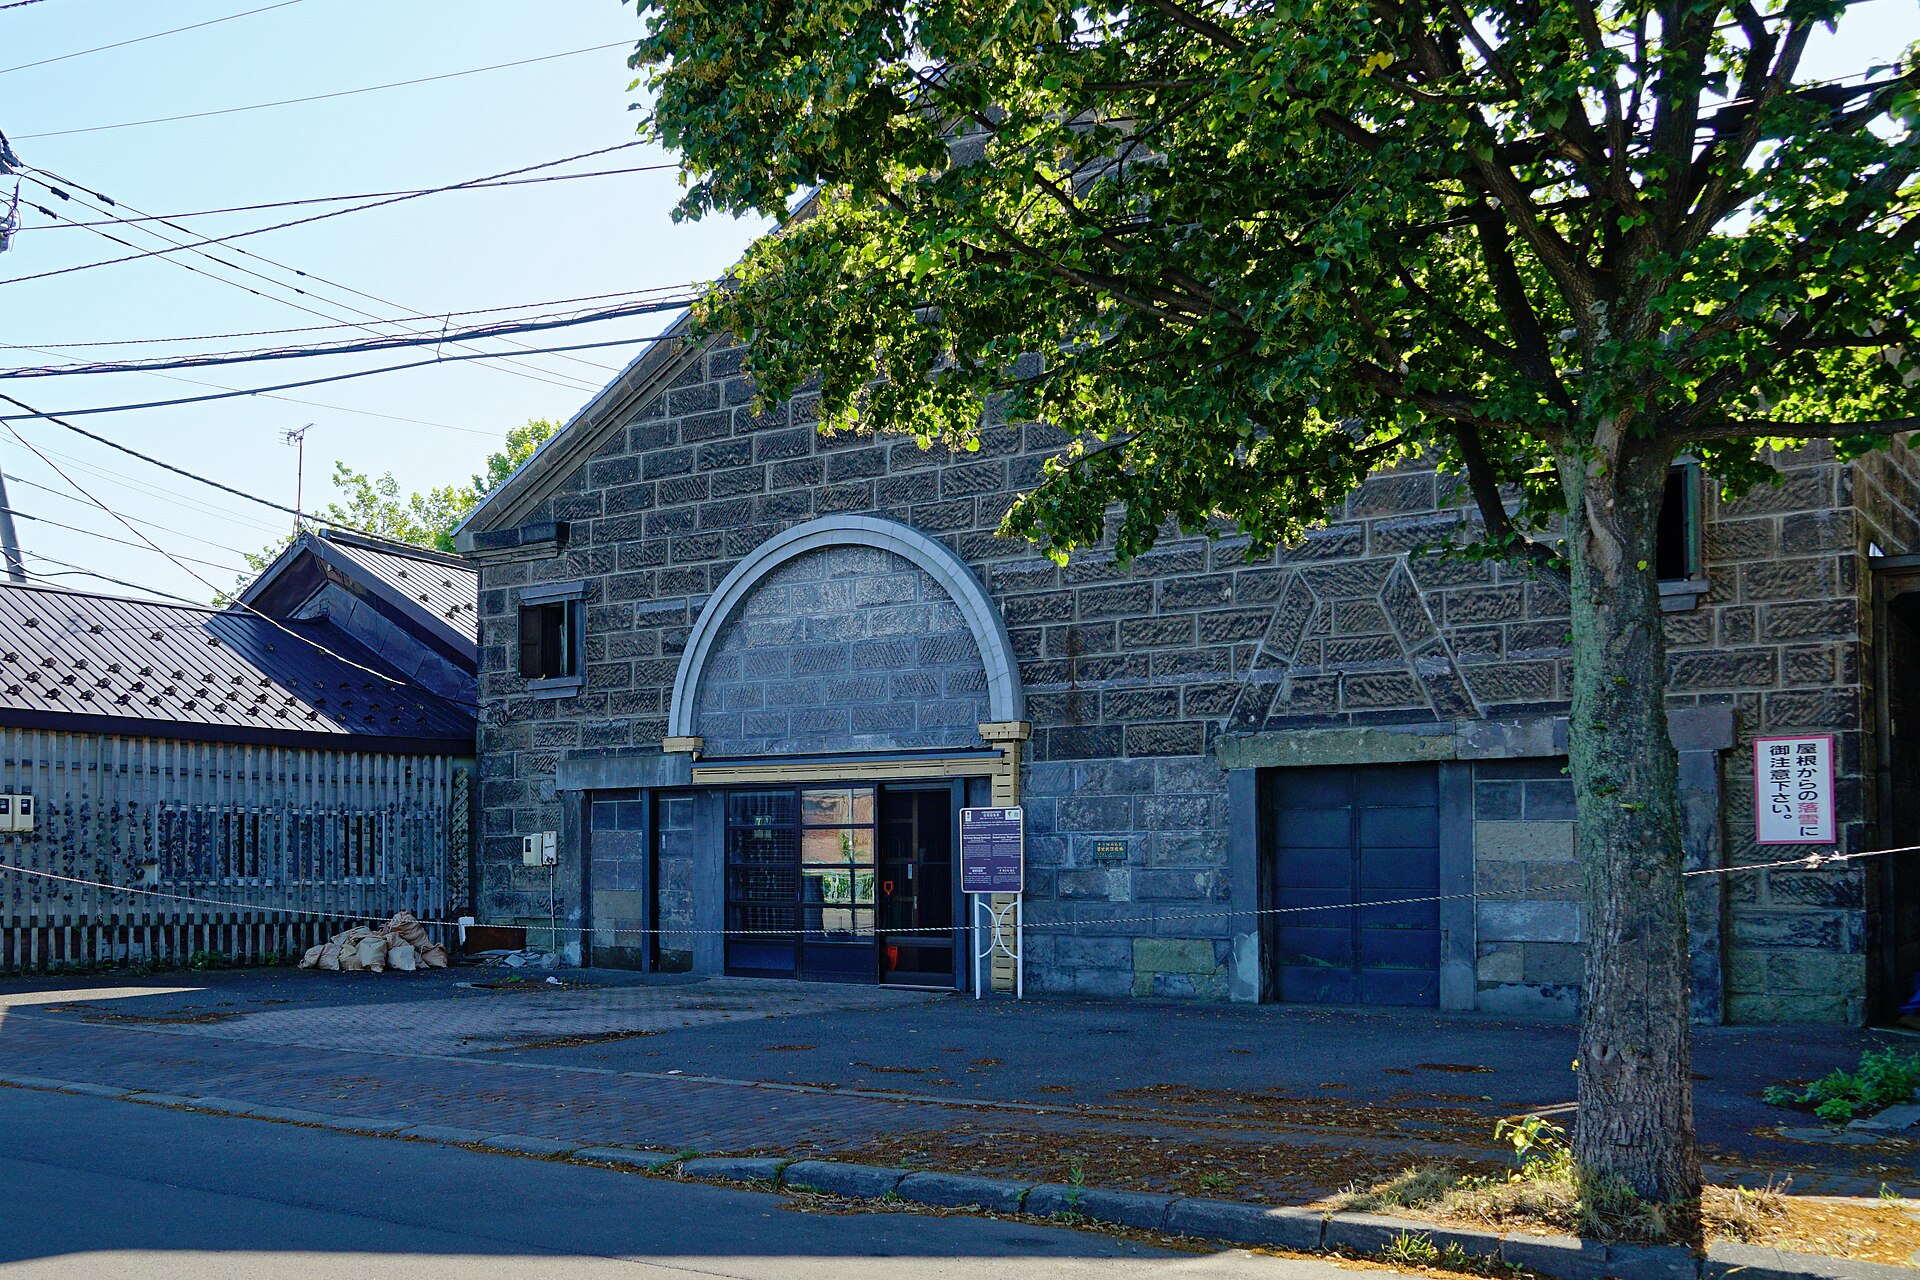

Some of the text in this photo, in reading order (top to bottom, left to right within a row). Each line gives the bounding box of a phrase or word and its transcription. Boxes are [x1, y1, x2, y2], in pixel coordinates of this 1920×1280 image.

[1769, 745, 1792, 820] 御注意下さい。
[1796, 743, 1819, 836] 屋根からの落雪に
